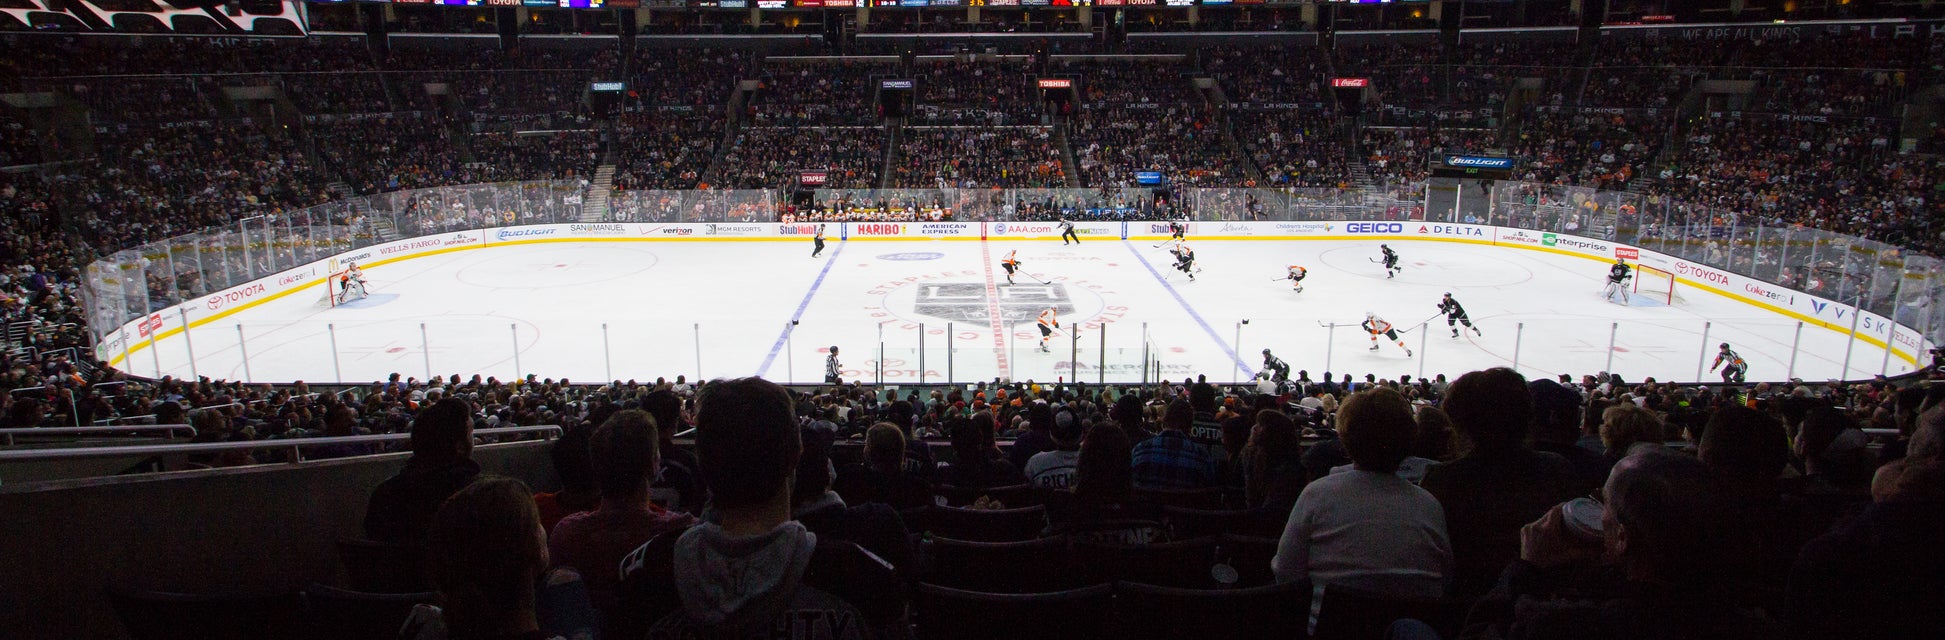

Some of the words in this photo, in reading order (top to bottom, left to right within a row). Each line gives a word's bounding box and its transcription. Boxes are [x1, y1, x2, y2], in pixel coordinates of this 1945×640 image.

[1453, 157, 1473, 166] BUD
[1473, 158, 1507, 166] LIGHT
[499, 228, 524, 238] BUD
[524, 228, 557, 236] LIGHT
[570, 224, 587, 232] SAN
[592, 224, 626, 232] MANUEL
[662, 226, 693, 235] verizon
[779, 225, 816, 235] StubHub!
[857, 224, 899, 235] HARIBO
[1008, 225, 1051, 233] AAA.com
[1151, 223, 1189, 234] Stub!
[1346, 223, 1403, 233] GEICO
[1433, 225, 1483, 237] DELTA
[379, 244, 409, 256] WELLS
[410, 238, 441, 251] FARGO
[340, 251, 372, 265] McDonald's
[1690, 266, 1730, 287] TOYOTA
[225, 282, 266, 304] TOYOTA
[842, 369, 943, 378] OYOTA
